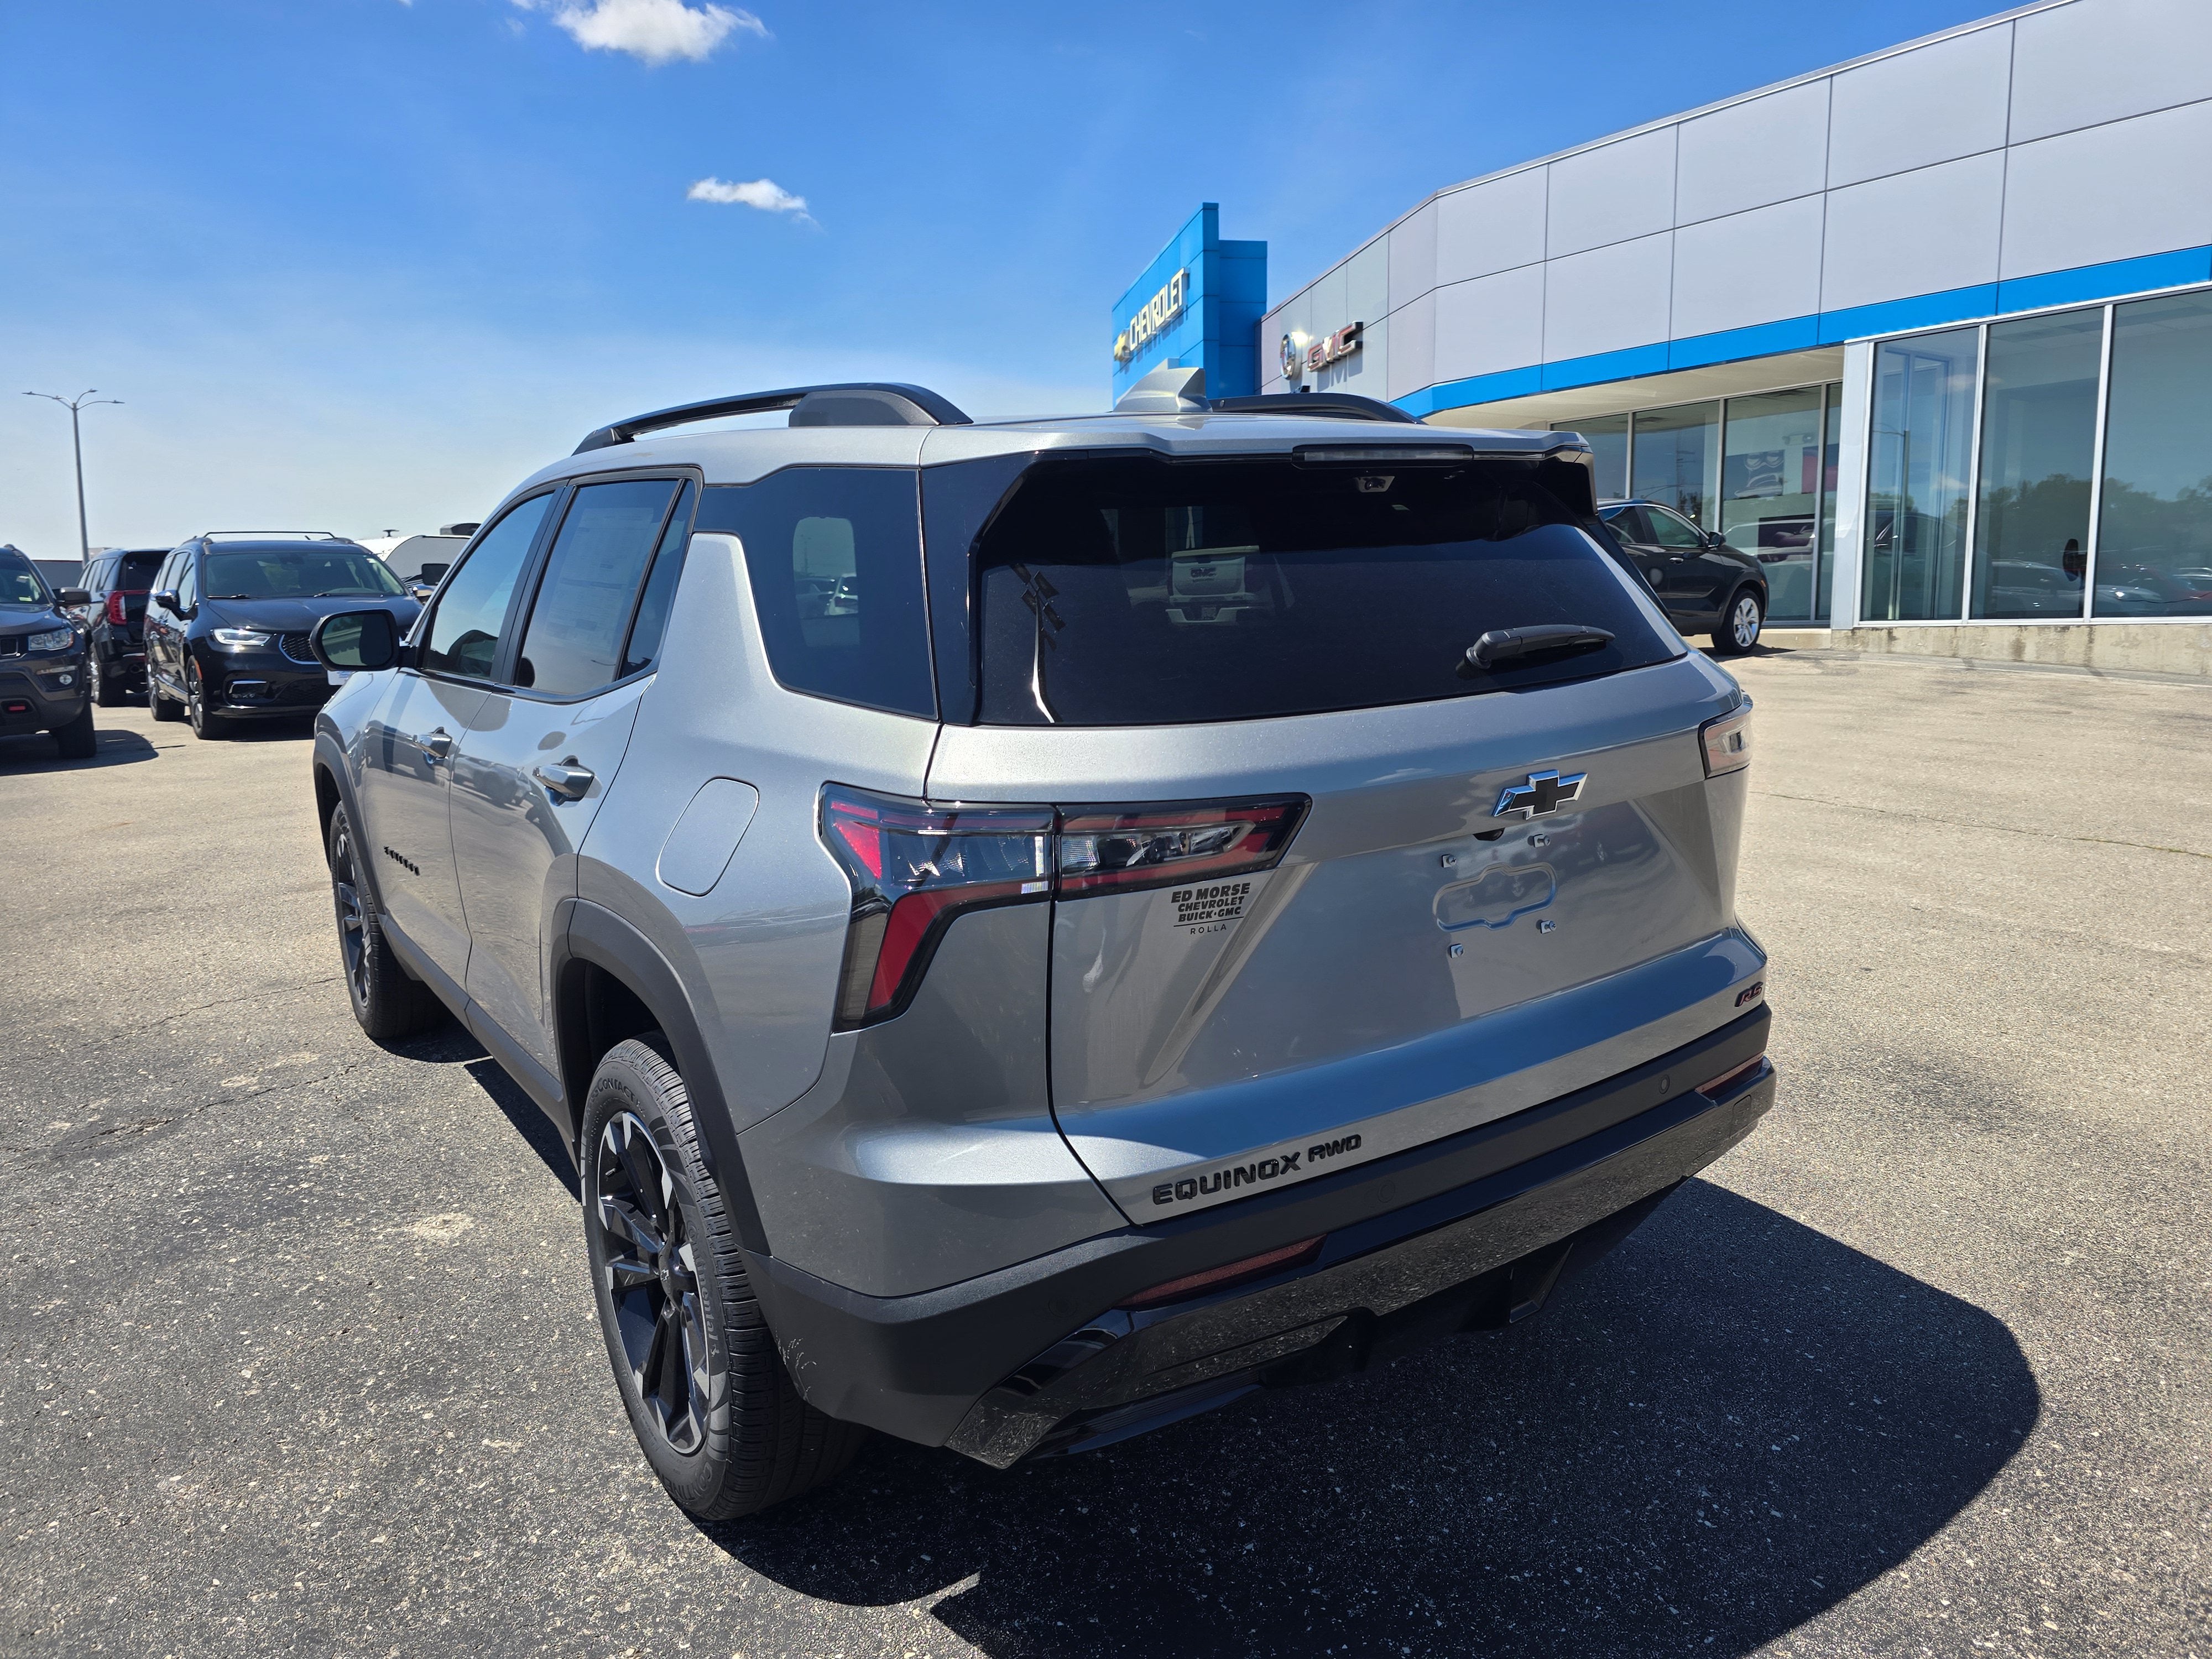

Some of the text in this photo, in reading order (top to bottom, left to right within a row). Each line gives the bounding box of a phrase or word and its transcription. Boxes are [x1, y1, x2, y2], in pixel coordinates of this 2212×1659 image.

[1130, 268, 1185, 351] CHEVROLET
[1307, 321, 1363, 373] GMC
[1171, 883, 1251, 904] ED MORSE
[1178, 896, 1245, 912] CHEVROLET
[1190, 924, 1227, 935] ROLLA
[1734, 981, 1764, 1007] RS
[1152, 1133, 1362, 1206] EQUINOX AWD
